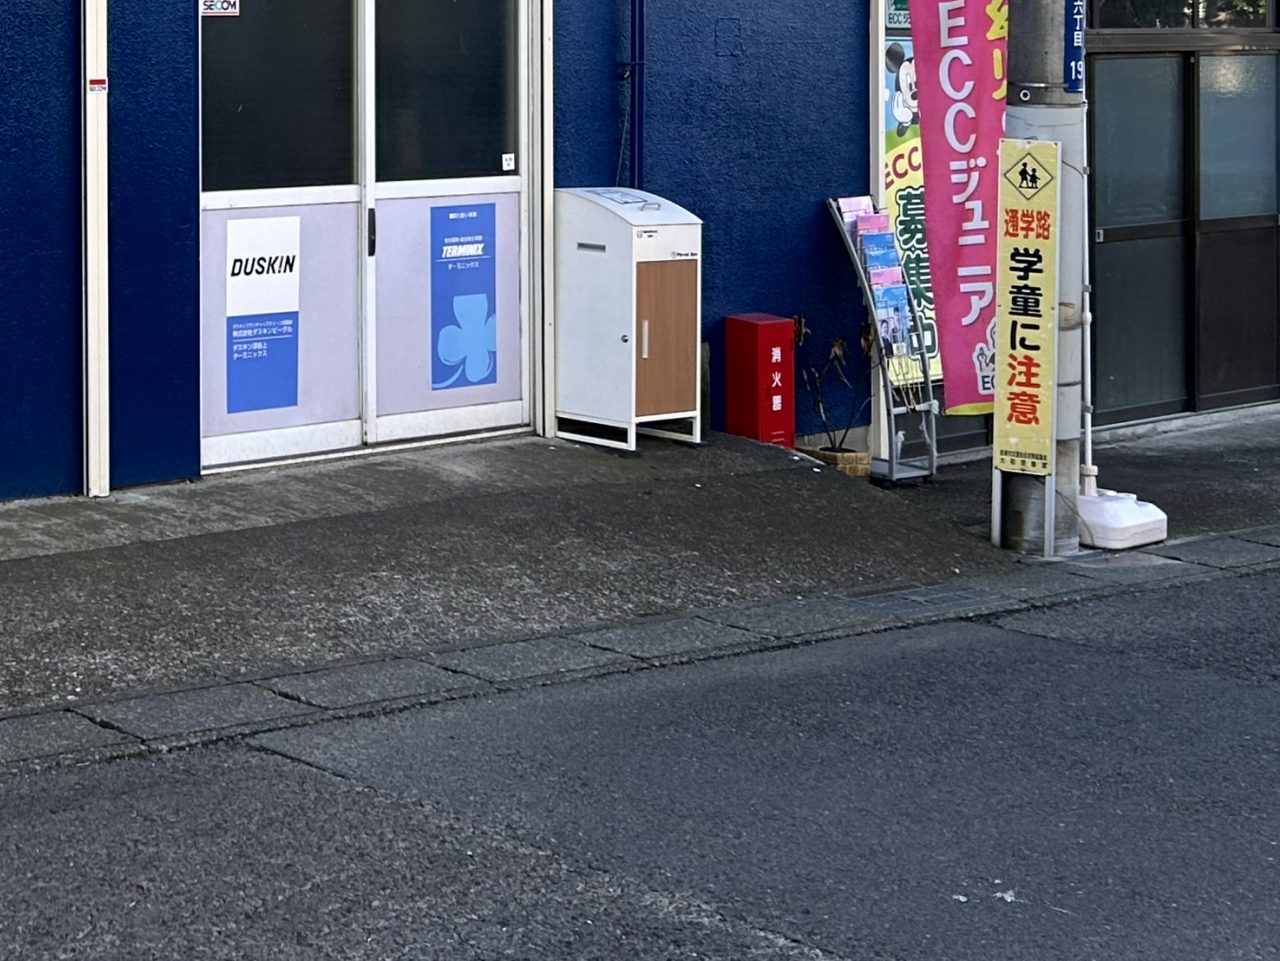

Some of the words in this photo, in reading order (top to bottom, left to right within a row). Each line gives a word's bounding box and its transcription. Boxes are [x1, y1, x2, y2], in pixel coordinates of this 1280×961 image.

[203, 0, 237, 11] SECOM
[1004, 208, 1051, 240] 通学路
[1007, 247, 1044, 425] 学童に注意
